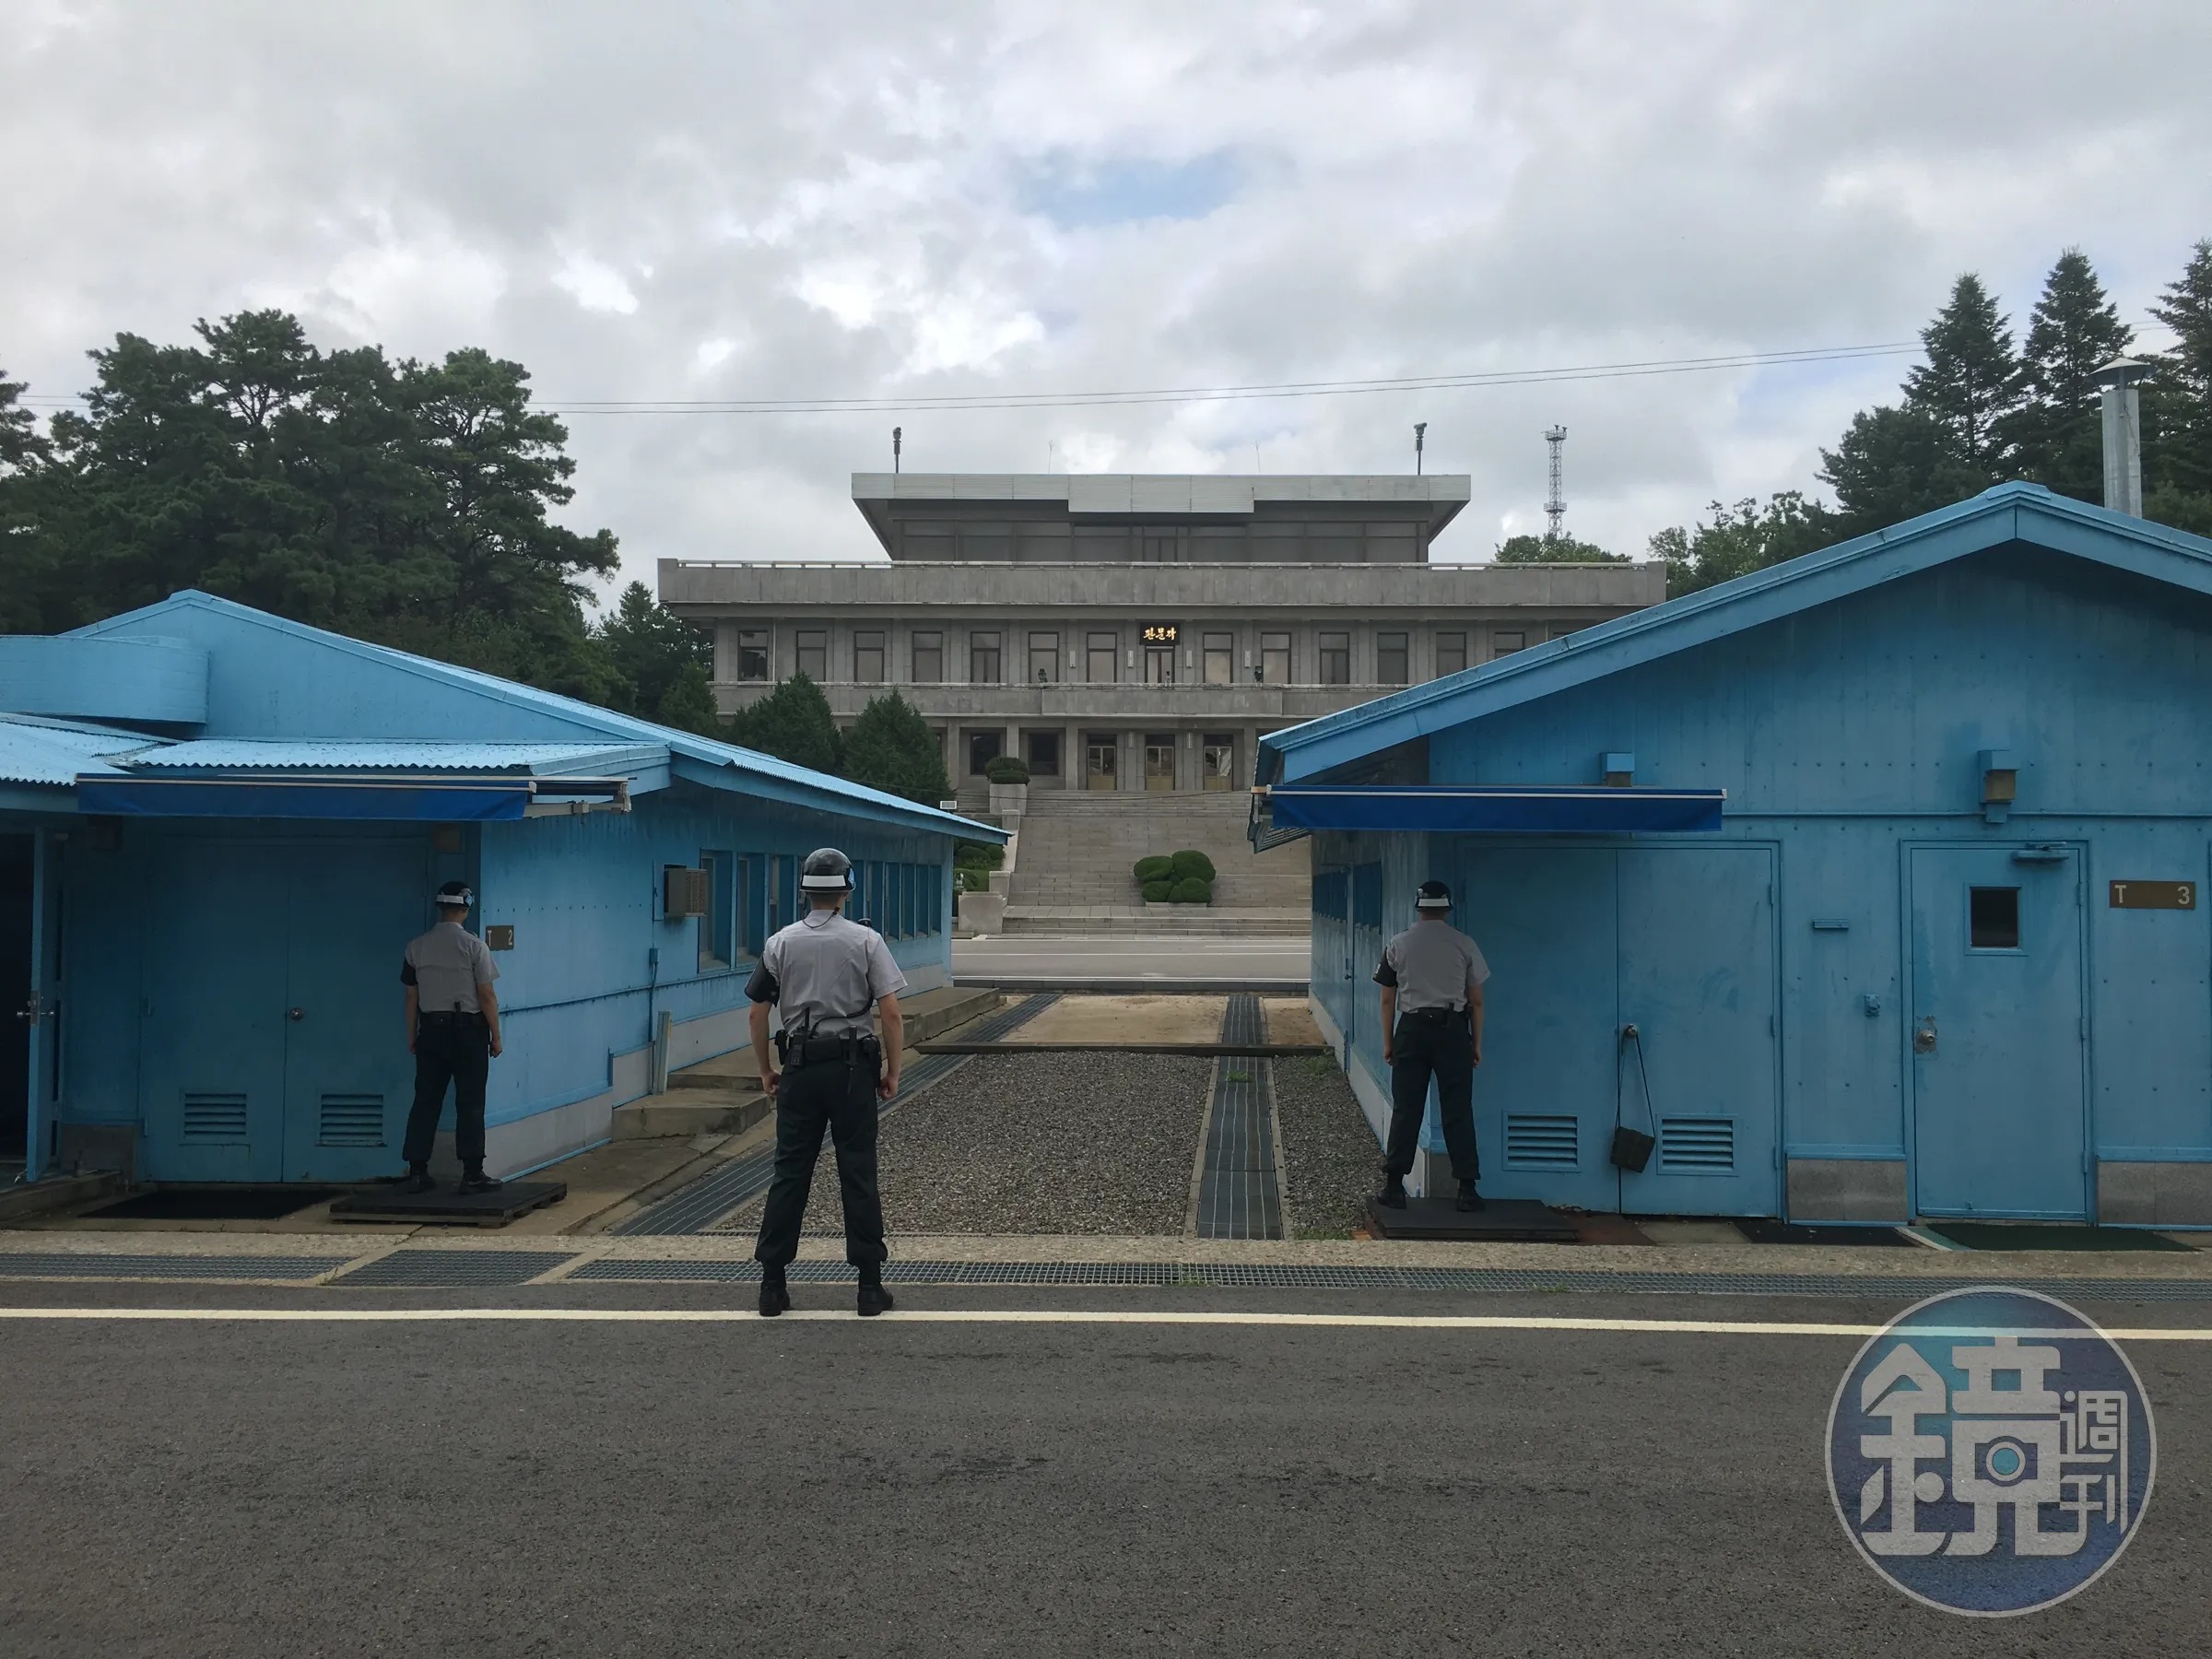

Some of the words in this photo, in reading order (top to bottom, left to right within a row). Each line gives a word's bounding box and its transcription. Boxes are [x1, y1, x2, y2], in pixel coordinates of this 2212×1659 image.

[1143, 627, 1177, 641] 판문각
[2114, 884, 2127, 904] T
[2177, 886, 2190, 905] 3
[488, 929, 492, 947] T
[508, 929, 512, 946] 2
